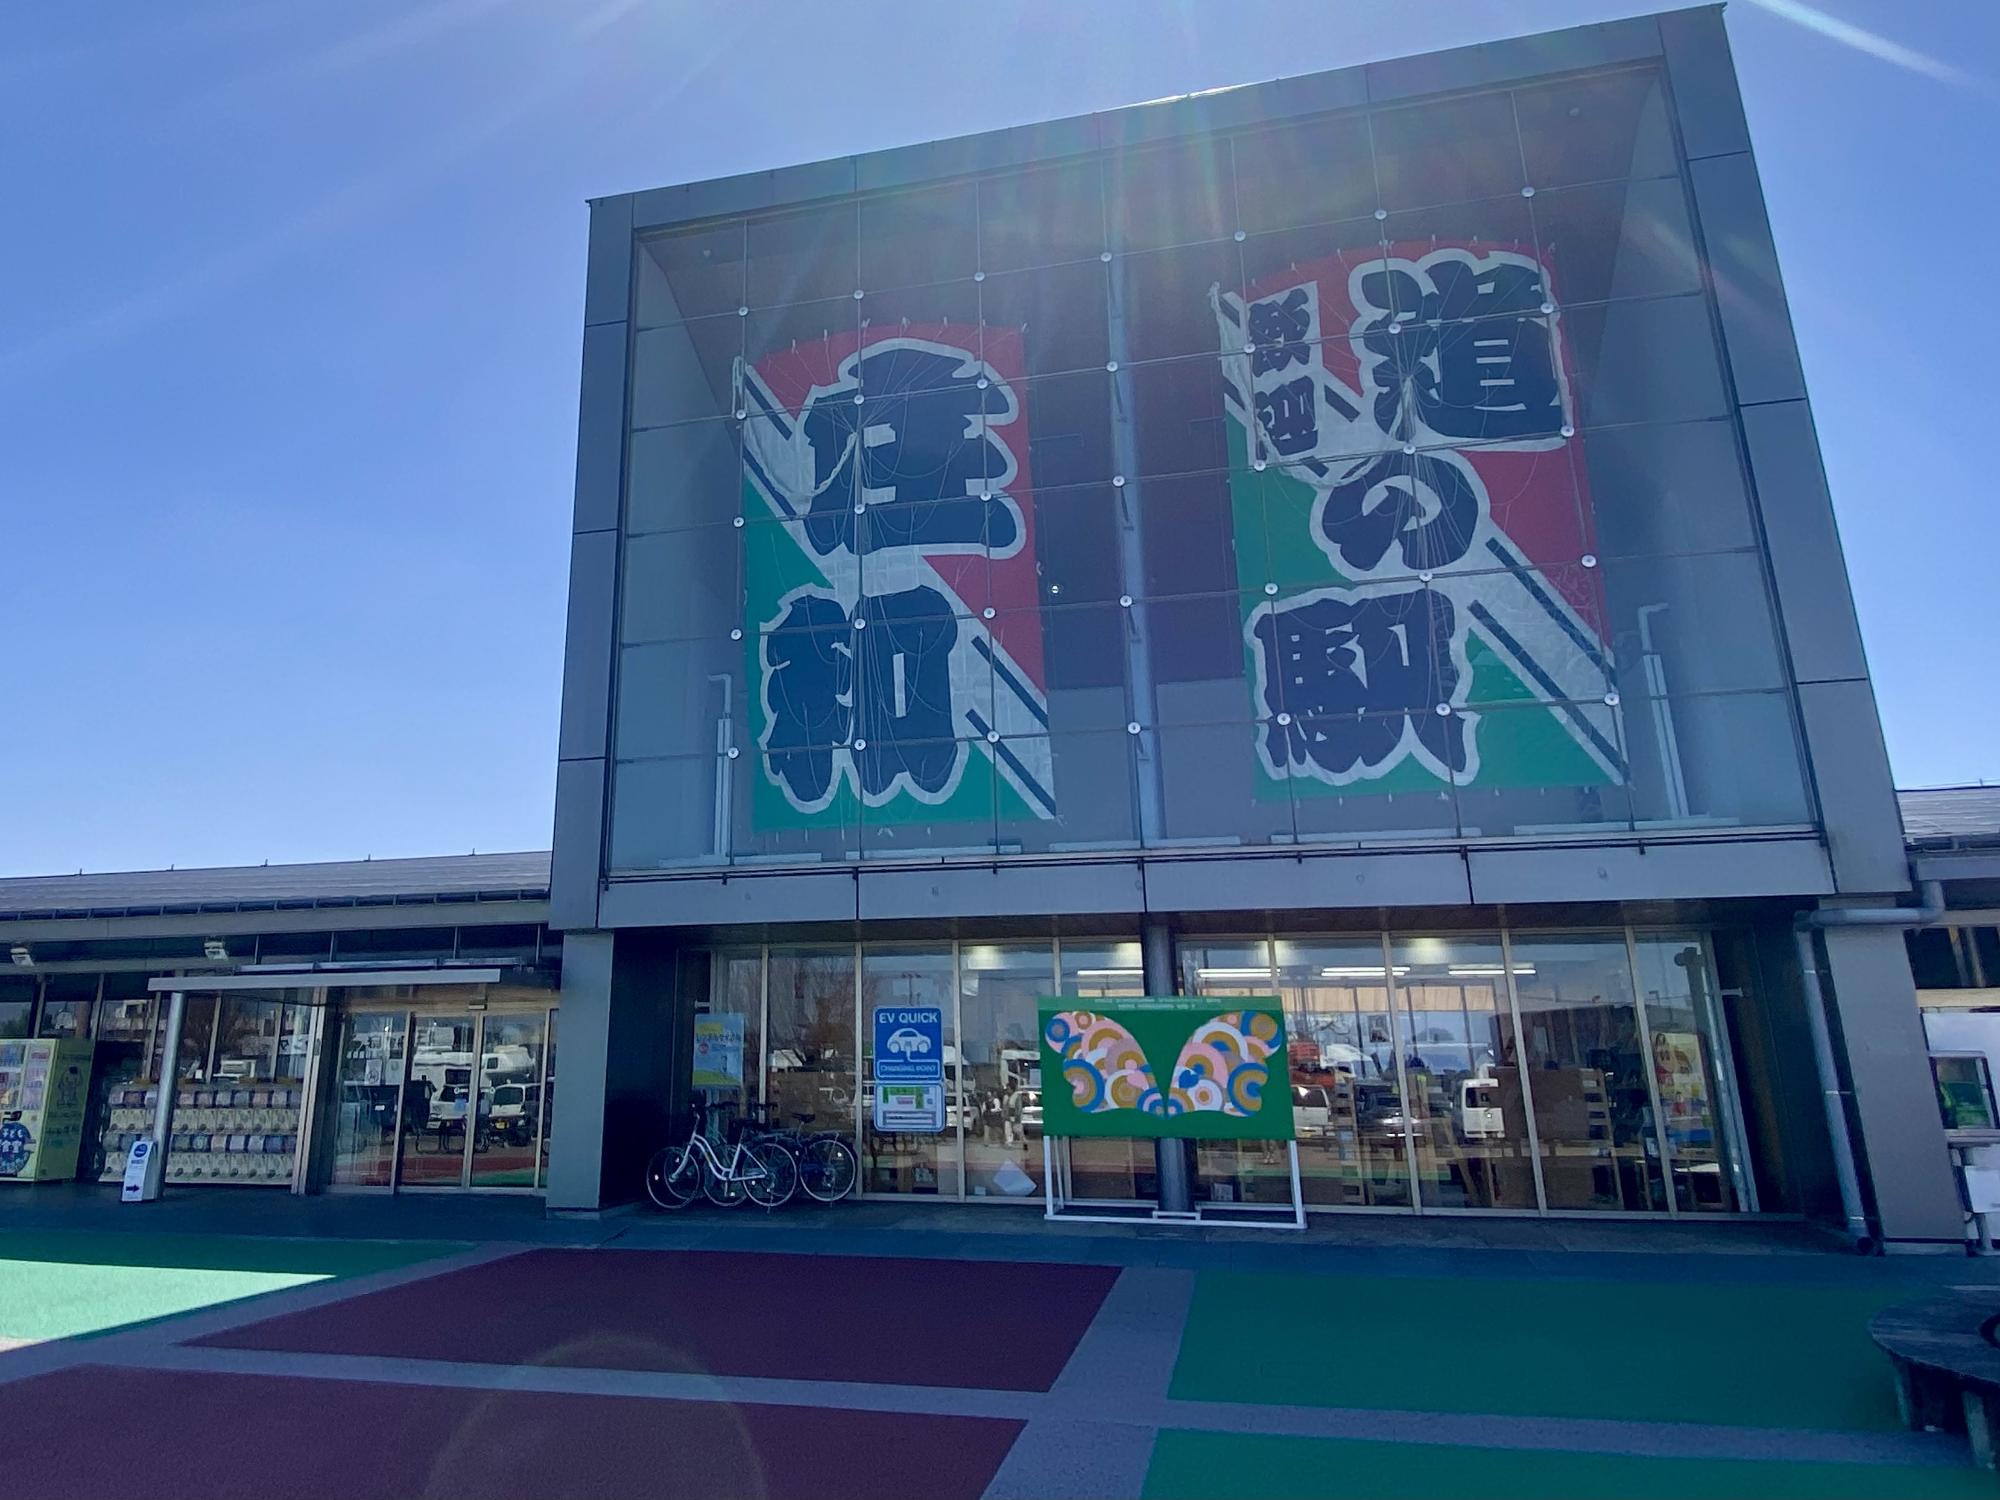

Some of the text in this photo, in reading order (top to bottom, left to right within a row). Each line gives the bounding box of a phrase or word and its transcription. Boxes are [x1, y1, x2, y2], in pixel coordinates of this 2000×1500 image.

[766, 346, 1019, 802] 庄和
[1252, 256, 1564, 778] 道の駅
[879, 1012, 938, 1024] EV QUICK
